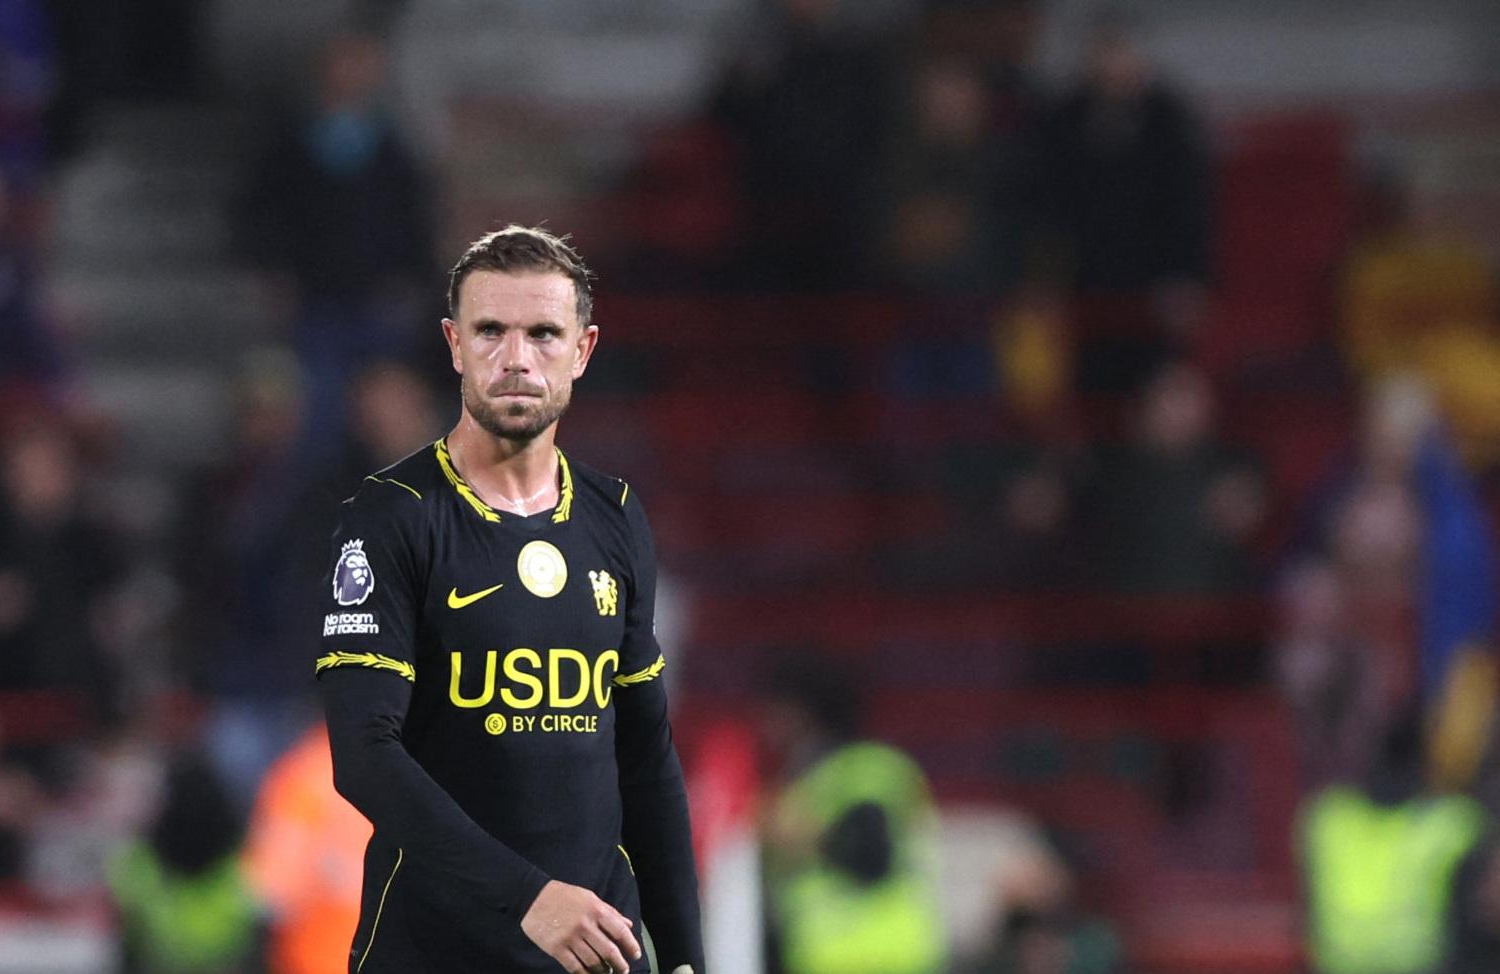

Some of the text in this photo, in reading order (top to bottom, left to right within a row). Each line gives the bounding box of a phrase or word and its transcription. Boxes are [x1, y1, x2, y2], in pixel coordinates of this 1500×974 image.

[325, 613, 373, 626] No room
[323, 623, 379, 637] for racism
[448, 648, 620, 710] USDC
[512, 715, 536, 732] BY
[541, 714, 598, 733] CIRCLE
